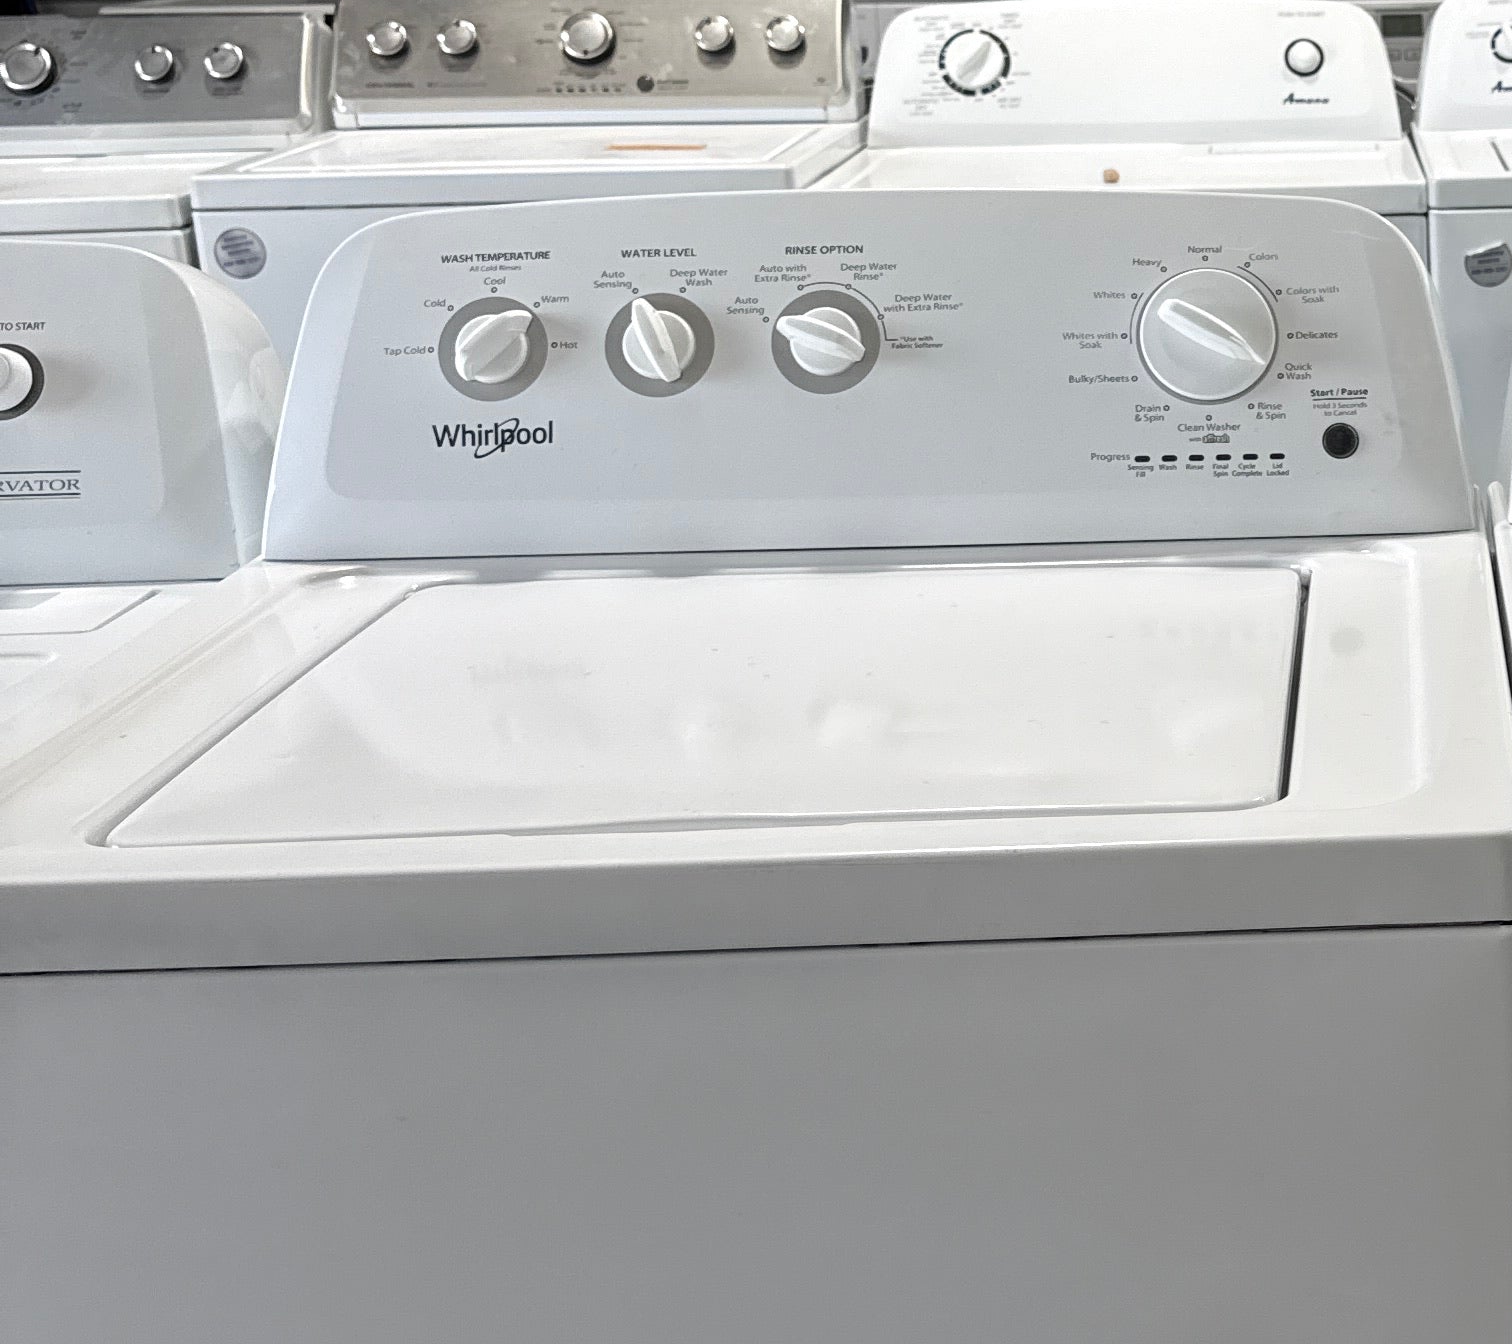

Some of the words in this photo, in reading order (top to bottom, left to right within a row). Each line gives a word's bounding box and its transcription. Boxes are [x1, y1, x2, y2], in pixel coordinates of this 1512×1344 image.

[621, 249, 661, 258] WATER
[664, 248, 697, 257] LEVEL
[785, 245, 817, 255] RINSE
[820, 244, 864, 255] OPTION
[1187, 245, 1223, 254] Normal
[441, 254, 473, 263] WASH
[475, 251, 551, 262] TEMPERATURE
[1132, 258, 1162, 267] Heavy
[759, 264, 784, 273] Auto
[785, 264, 807, 272] with
[840, 263, 866, 273] Deep
[868, 262, 897, 271] Water
[601, 270, 625, 279] Auto
[670, 269, 697, 279] Deep
[699, 268, 728, 277] Water
[484, 276, 507, 286] Cool
[685, 278, 713, 287] Wash
[754, 274, 779, 283] Extra
[593, 280, 632, 290] Sensing
[1093, 291, 1126, 300] Whites
[1286, 287, 1317, 296] Colors
[1318, 286, 1340, 294] with
[541, 295, 570, 303] Warm
[734, 296, 758, 305] Auto
[894, 293, 922, 303] Deep
[923, 293, 952, 301] Water
[1301, 295, 1325, 304] Soak
[423, 299, 446, 308] Cold
[883, 304, 905, 313] with
[907, 303, 932, 312] Extra
[726, 306, 765, 316] Sensing
[15, 322, 46, 331] START
[1062, 332, 1095, 340] Whites
[1096, 331, 1119, 339] with
[1295, 331, 1338, 339] Delicates
[559, 341, 578, 349] Hot
[384, 347, 402, 358] Tap
[404, 346, 426, 355] Cold
[1284, 362, 1313, 372] Quick
[1068, 375, 1130, 384] Bulky/Sheets
[1286, 372, 1312, 380] Wash
[1310, 389, 1334, 397] Start
[1341, 388, 1369, 396] Pause
[1135, 404, 1161, 413] Drain
[1257, 402, 1283, 410] Rinse
[1134, 414, 1142, 422] &
[1143, 414, 1165, 423] Spin
[1256, 412, 1263, 420] &
[1265, 412, 1287, 421] Spin
[1177, 424, 1204, 432] Clean
[1206, 423, 1241, 431] Washer
[432, 419, 553, 456] Whirlpool
[1090, 453, 1131, 462] Progress
